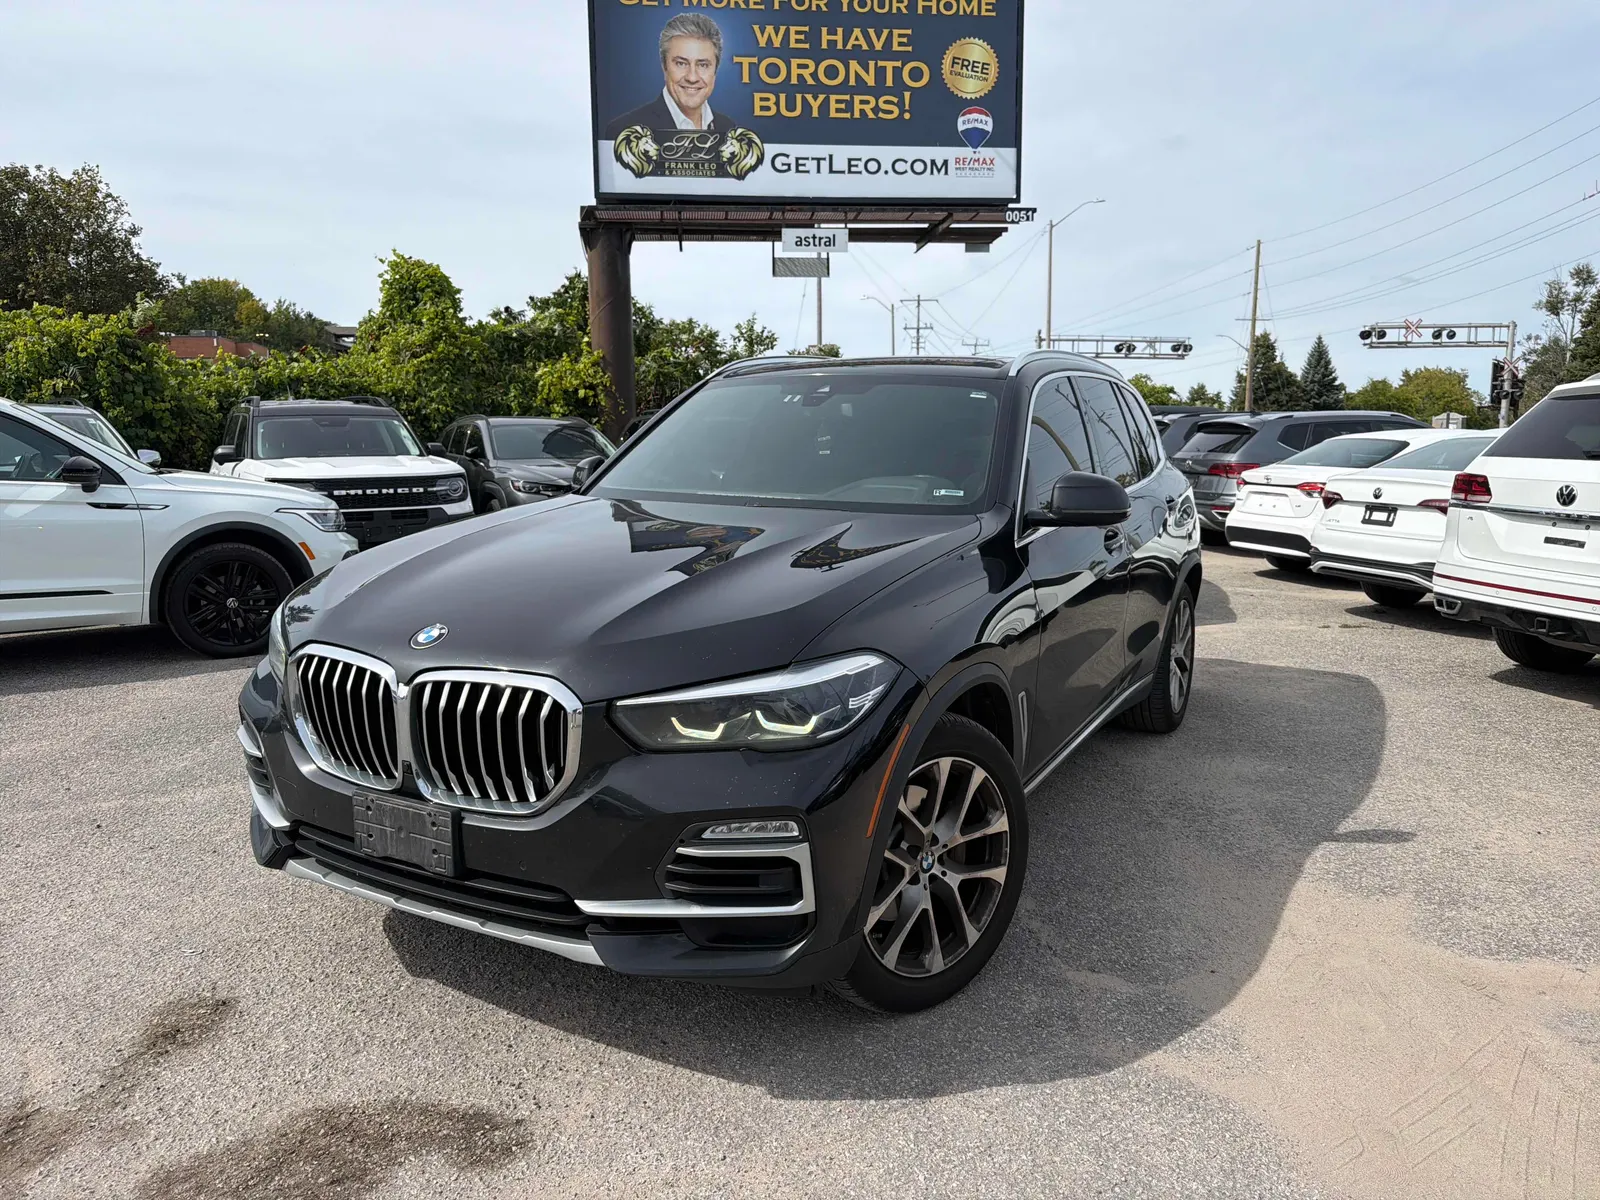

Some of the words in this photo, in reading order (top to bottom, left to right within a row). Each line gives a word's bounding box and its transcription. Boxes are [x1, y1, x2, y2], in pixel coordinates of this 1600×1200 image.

[917, 0, 997, 17] HOME
[752, 25, 810, 49] WE
[820, 27, 913, 52] HAVE
[733, 55, 931, 88] TORONTO
[951, 56, 990, 75] FREE
[950, 69, 989, 82] EVALUATION
[753, 91, 912, 120] BUYERS!
[962, 117, 988, 126] RE/MAX
[664, 162, 695, 170] FRANK
[698, 162, 717, 170] LEO
[954, 157, 995, 167] RE/MAX
[1005, 210, 1033, 222] 0051
[794, 233, 836, 247] astral
[333, 487, 424, 496] BRONCO
